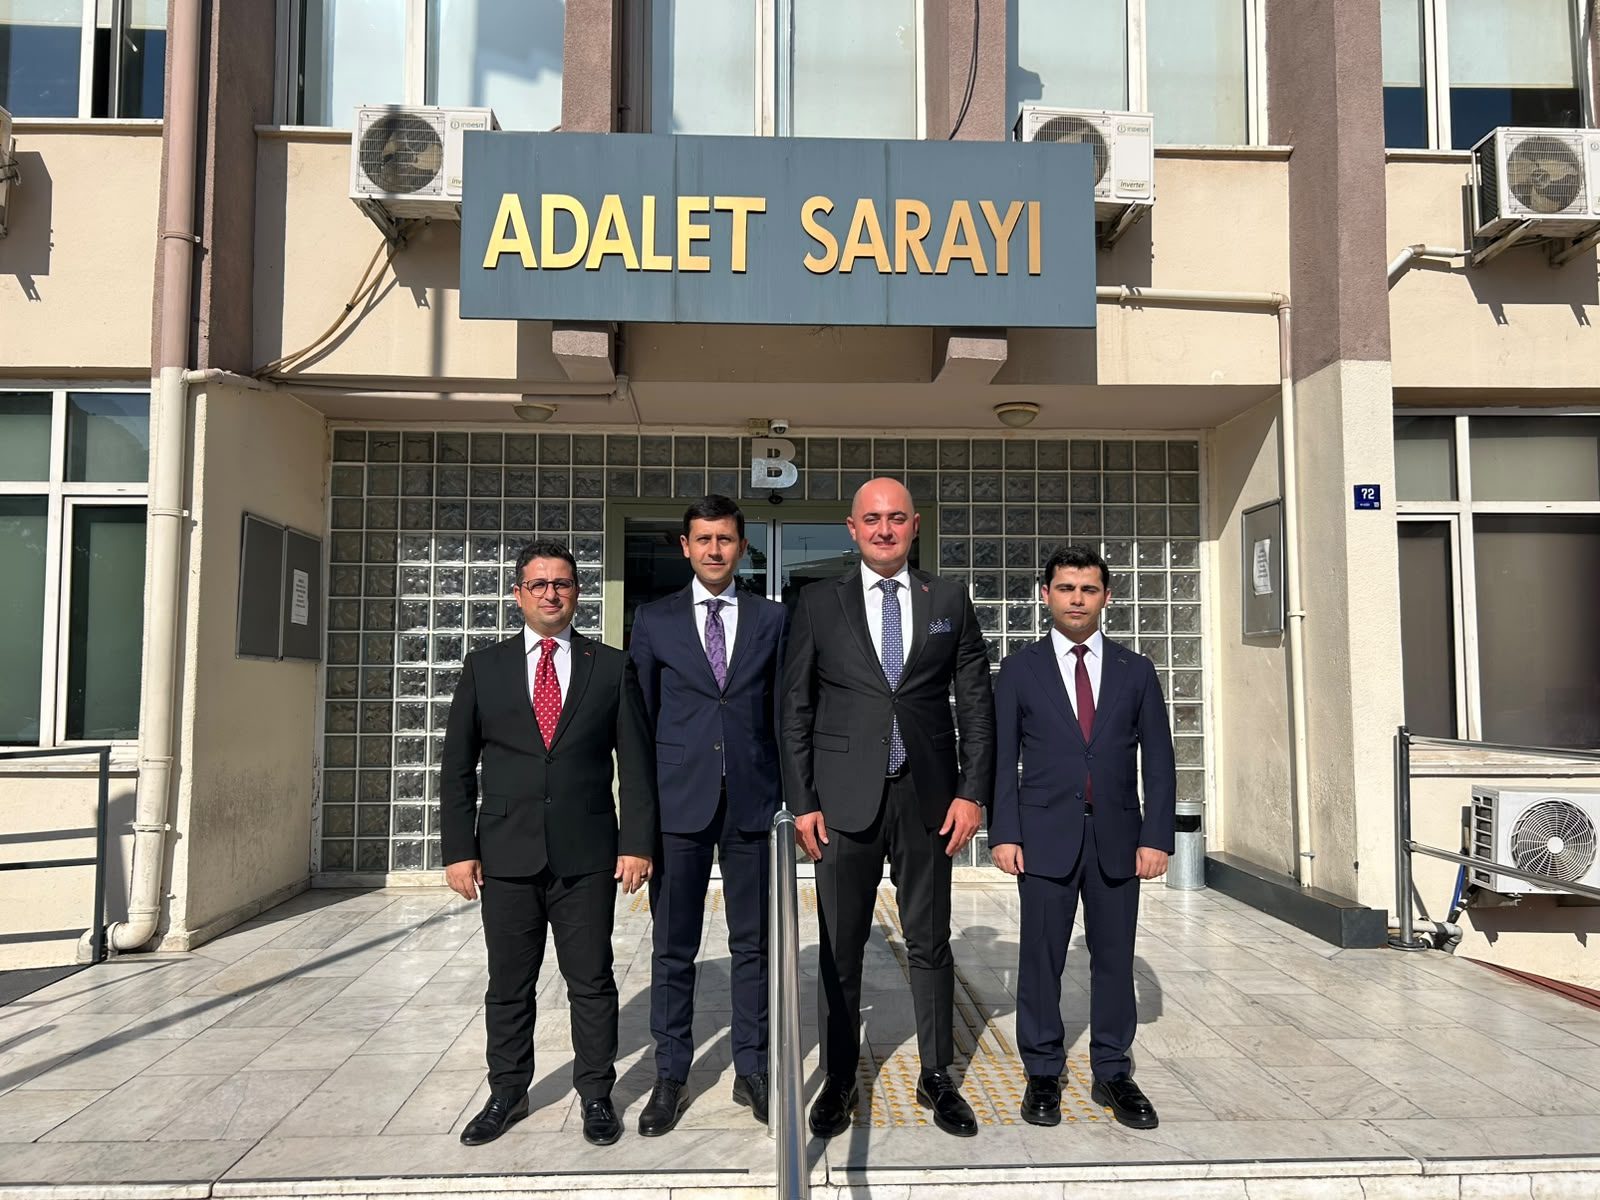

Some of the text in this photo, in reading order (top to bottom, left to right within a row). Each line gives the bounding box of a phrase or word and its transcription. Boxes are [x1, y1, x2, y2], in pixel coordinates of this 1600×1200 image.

[483, 194, 1041, 276] ADALET SARAYI
[751, 438, 798, 488] B
[1361, 488, 1375, 500] 72
